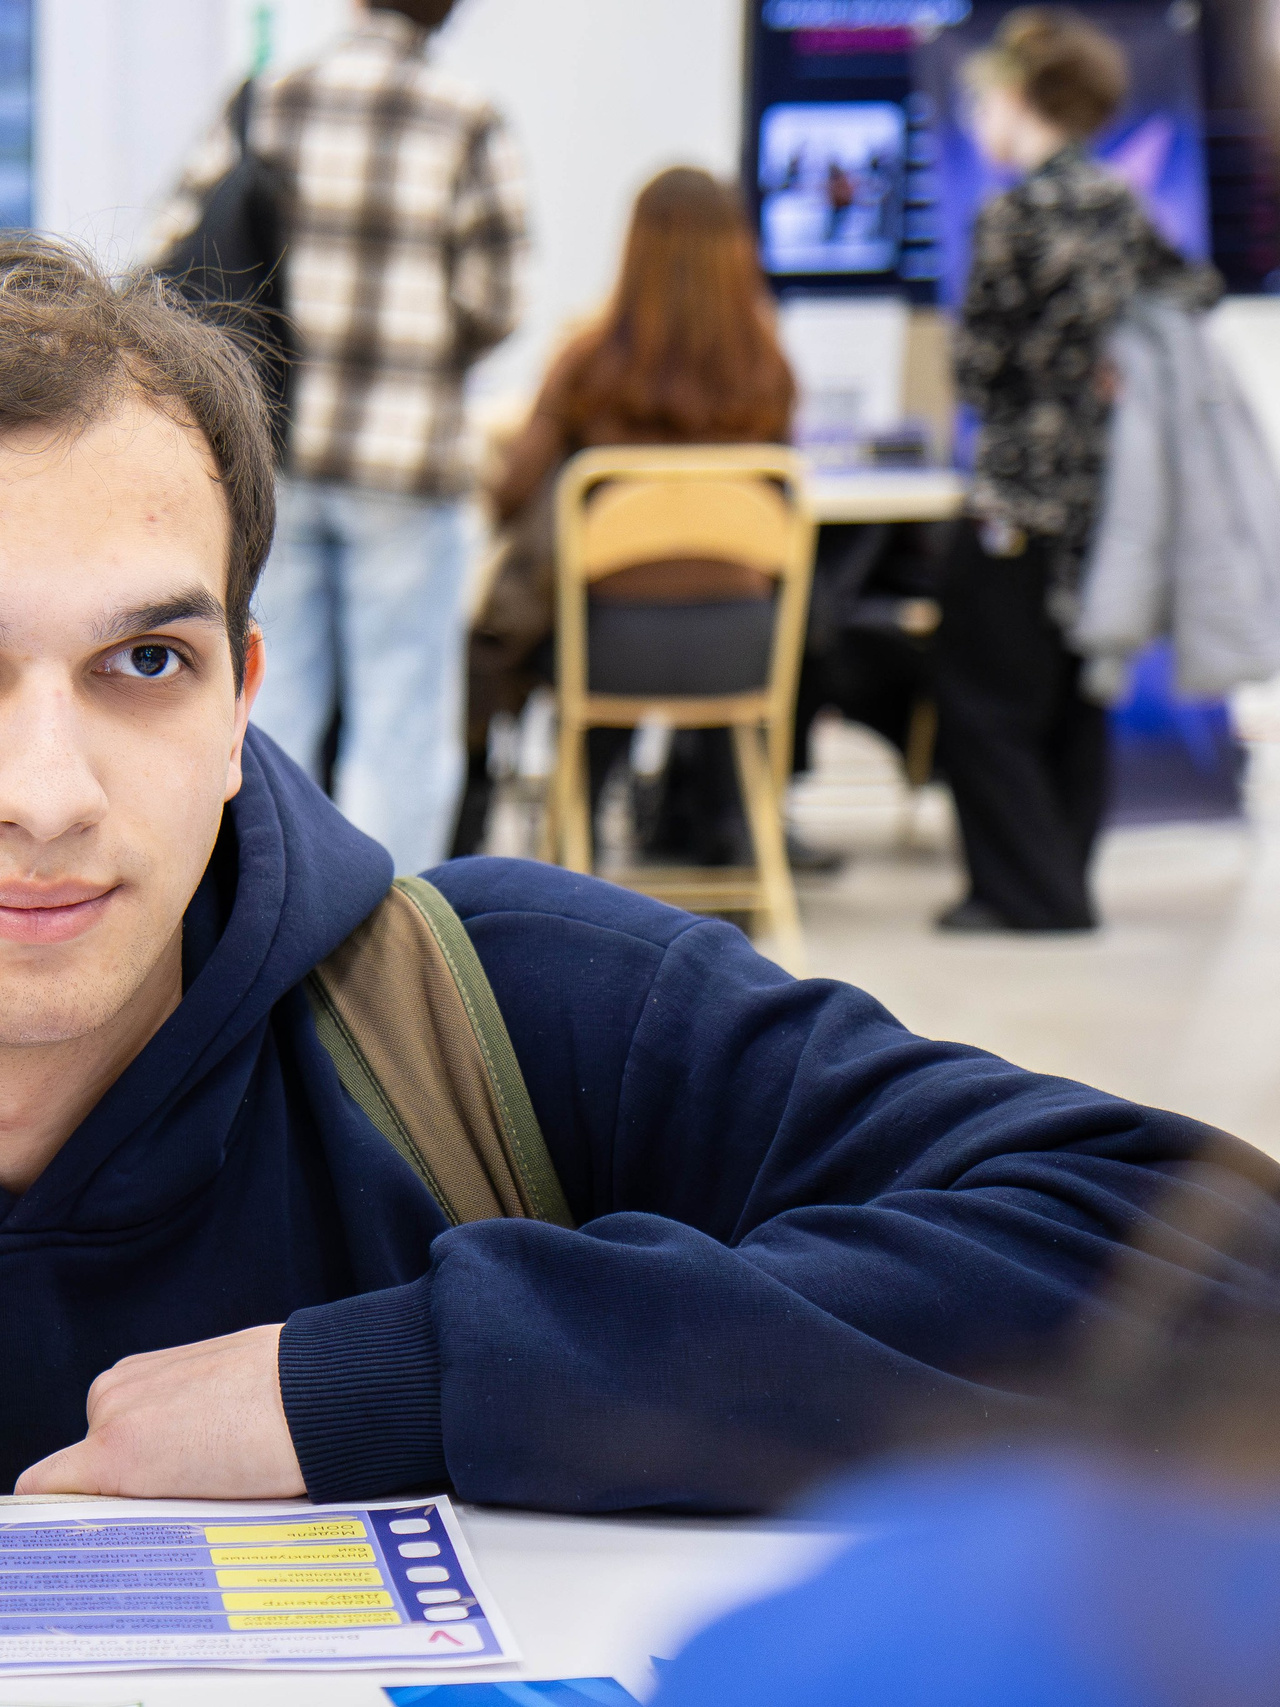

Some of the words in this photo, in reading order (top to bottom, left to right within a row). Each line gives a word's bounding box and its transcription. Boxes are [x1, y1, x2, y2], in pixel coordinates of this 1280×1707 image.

[122, 1533, 193, 1541] проблему
[286, 1530, 356, 1538] Модель
[94, 1538, 194, 1547] Сформулируй
[220, 1553, 369, 1561] Интеллектуальные
[13, 1558, 130, 1566] представителя
[142, 1570, 204, 1578] должен
[262, 1599, 382, 1607] Медиацентр
[294, 1612, 392, 1620] волонтеров
[243, 1618, 338, 1626] подготовки
[126, 1638, 175, 1646] приз
[237, 1634, 360, 1643] Выполнишь
